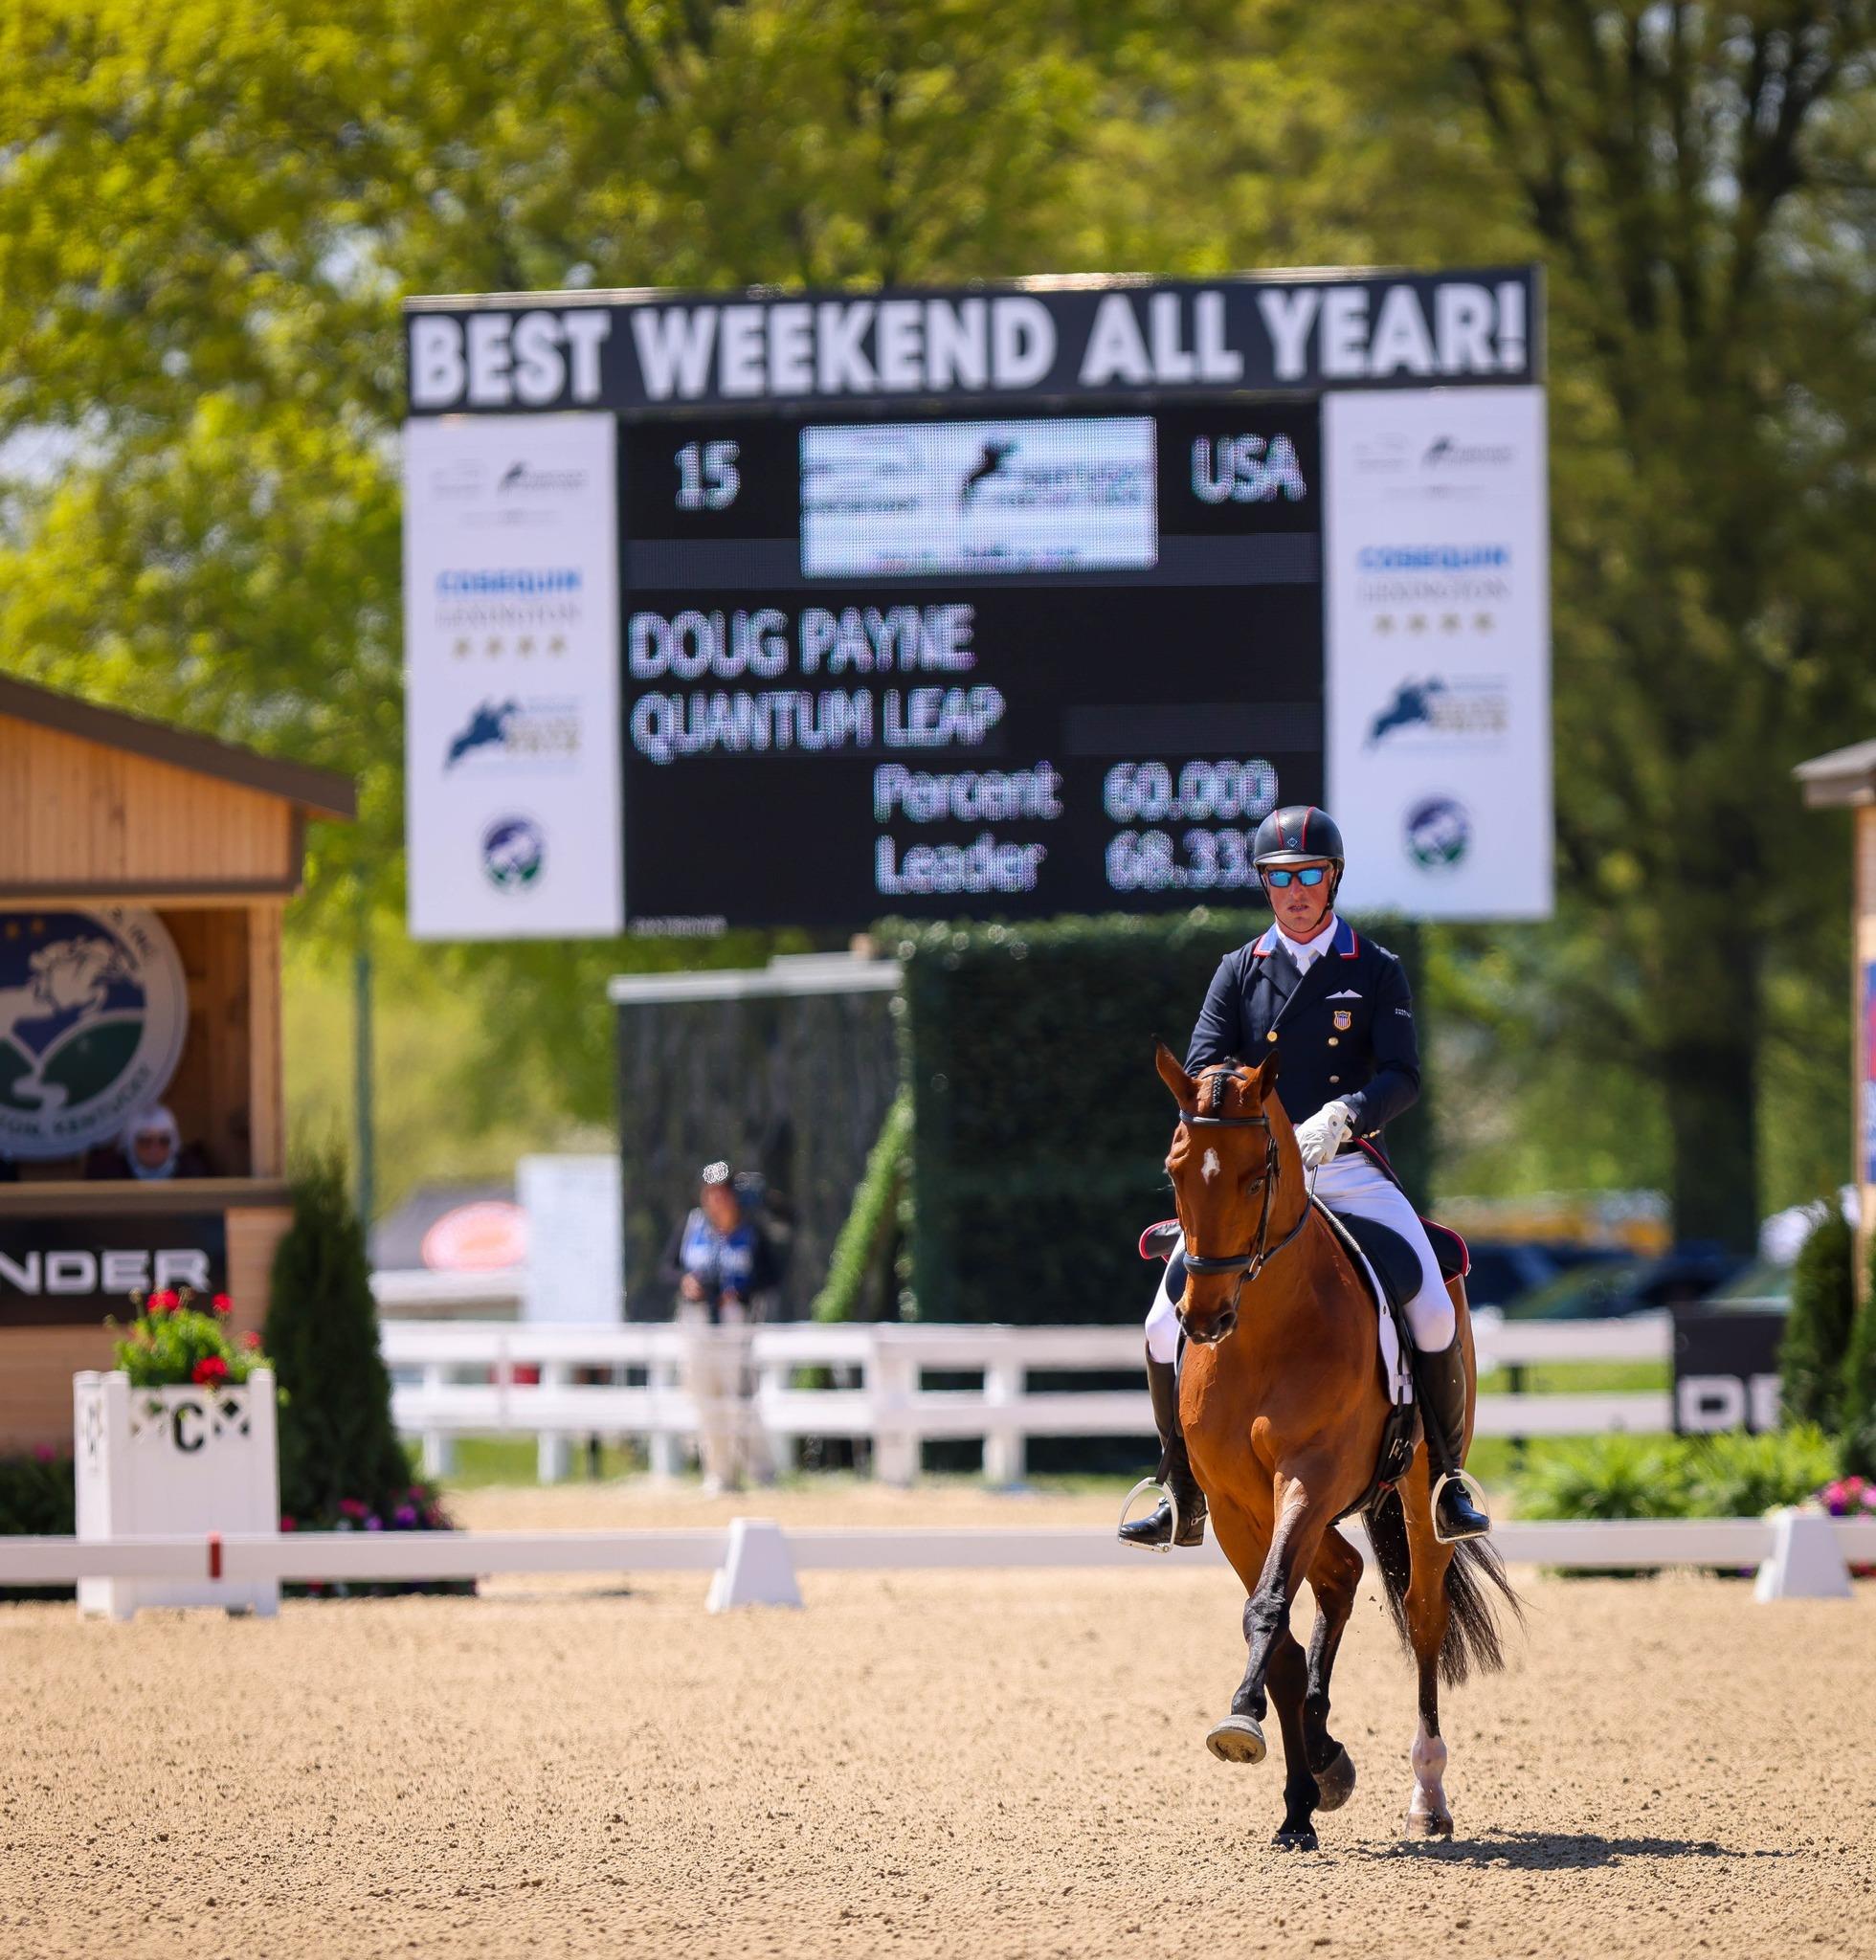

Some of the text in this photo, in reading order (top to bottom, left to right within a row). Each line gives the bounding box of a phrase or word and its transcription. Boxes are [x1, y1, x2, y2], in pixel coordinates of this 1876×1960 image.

[410, 281, 1527, 409] BEST WEEKEND ALL YEAR!
[674, 439, 741, 511] 15
[1192, 434, 1306, 504] USA
[628, 604, 974, 679] DOUG PAYNE
[630, 687, 874, 766] QUANTUM
[882, 682, 1006, 748] LEAP
[873, 759, 1280, 823] Percent 60.000
[874, 831, 1048, 896] Leader
[172, 1400, 205, 1453] C
